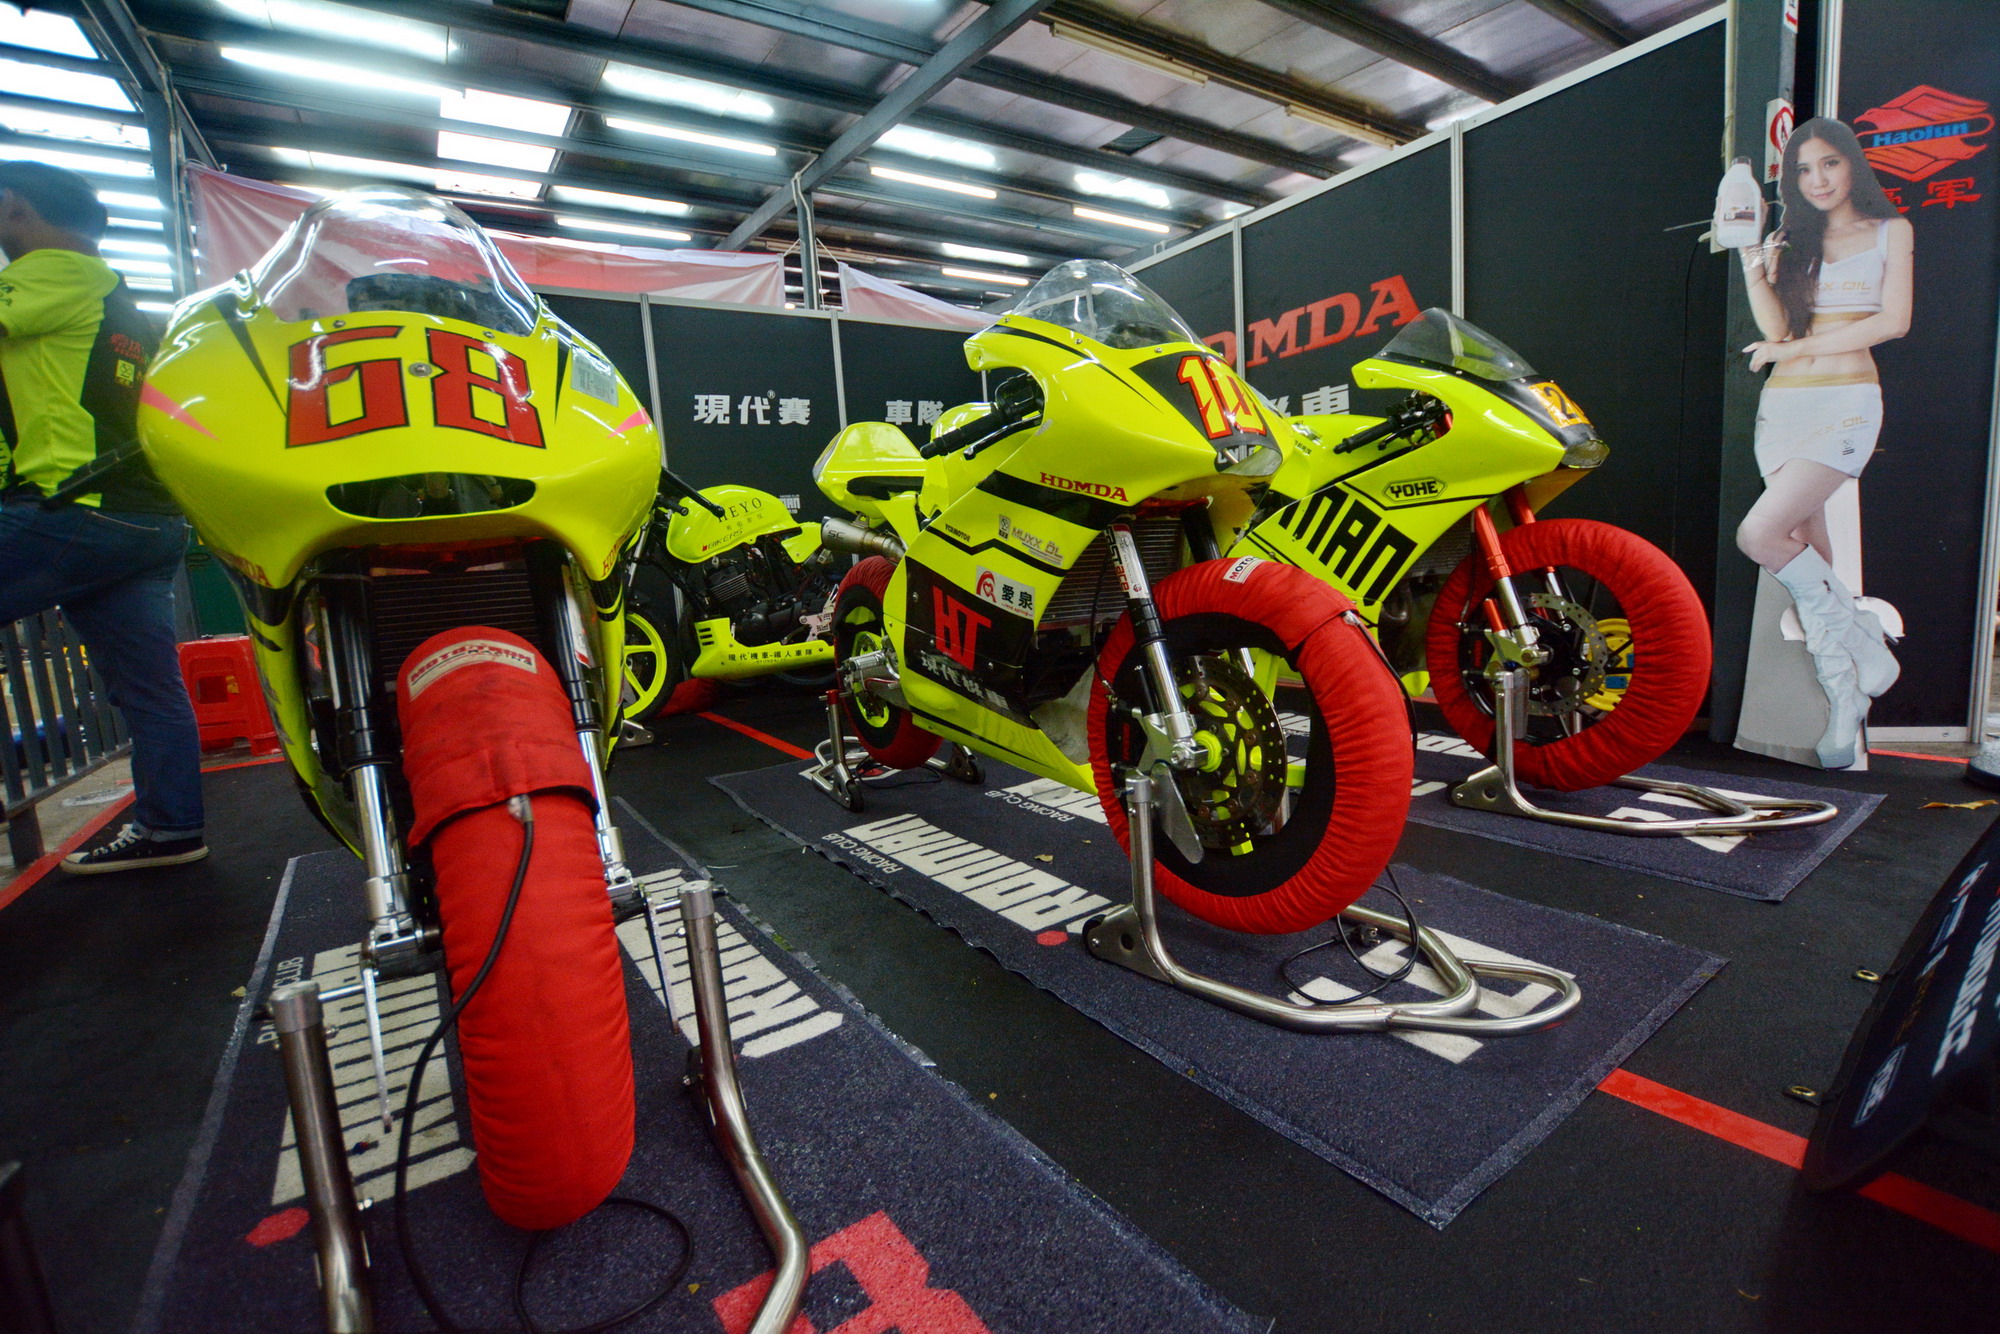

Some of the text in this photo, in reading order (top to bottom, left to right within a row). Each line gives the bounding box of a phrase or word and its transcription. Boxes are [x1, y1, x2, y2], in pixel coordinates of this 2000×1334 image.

[285, 325, 547, 449] 68
[1040, 472, 1129, 502] HDMDA
[1390, 481, 1439, 498] YOHE
[1001, 584, 1033, 611] 愛泉
[821, 832, 904, 874] RACING CLUB
